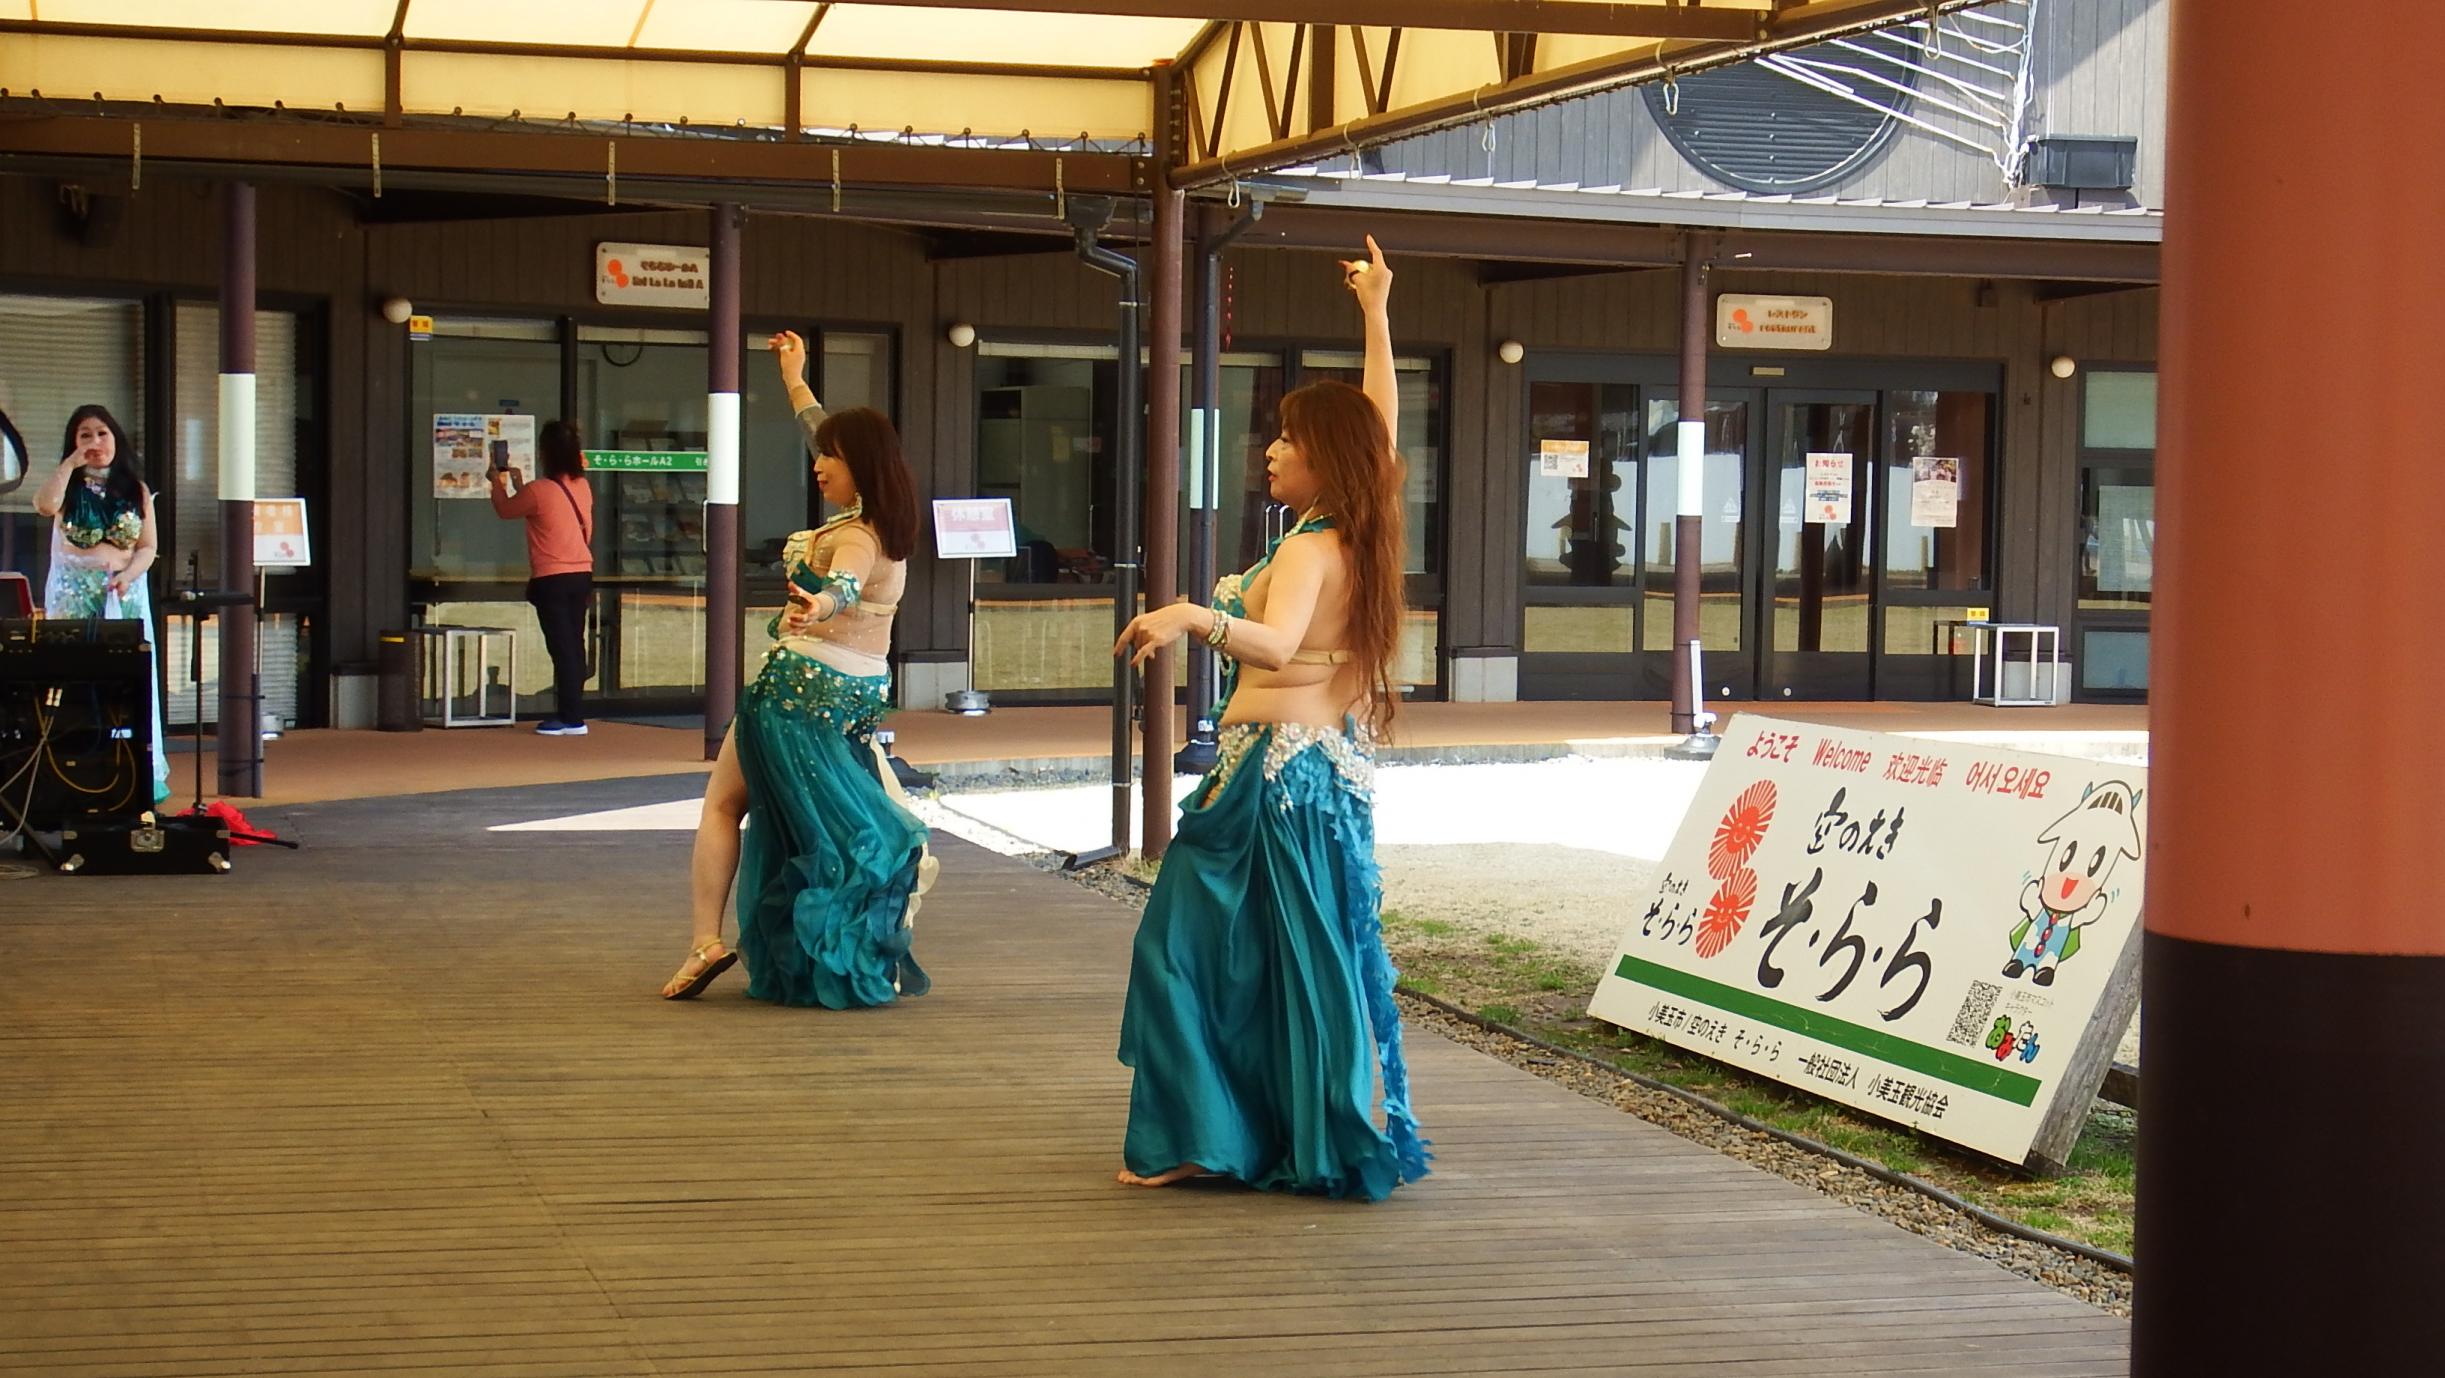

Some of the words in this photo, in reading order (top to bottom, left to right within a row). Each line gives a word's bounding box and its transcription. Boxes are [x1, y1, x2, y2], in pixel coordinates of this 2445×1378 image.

[1746, 730, 1800, 764] ようこそ
[1811, 738, 1872, 773] Welcome
[1882, 751, 1948, 788] 欢迎光临
[1807, 787, 1905, 860] 空のえき
[1642, 897, 1698, 946] そ・ら・ら
[1757, 866, 1943, 1022] そ・ら・ら
[1733, 1029, 1783, 1062] そ・ら・ら
[1798, 1051, 1861, 1091] 一般社団法人
[1866, 1073, 1950, 1120] 小美玉観光協会
